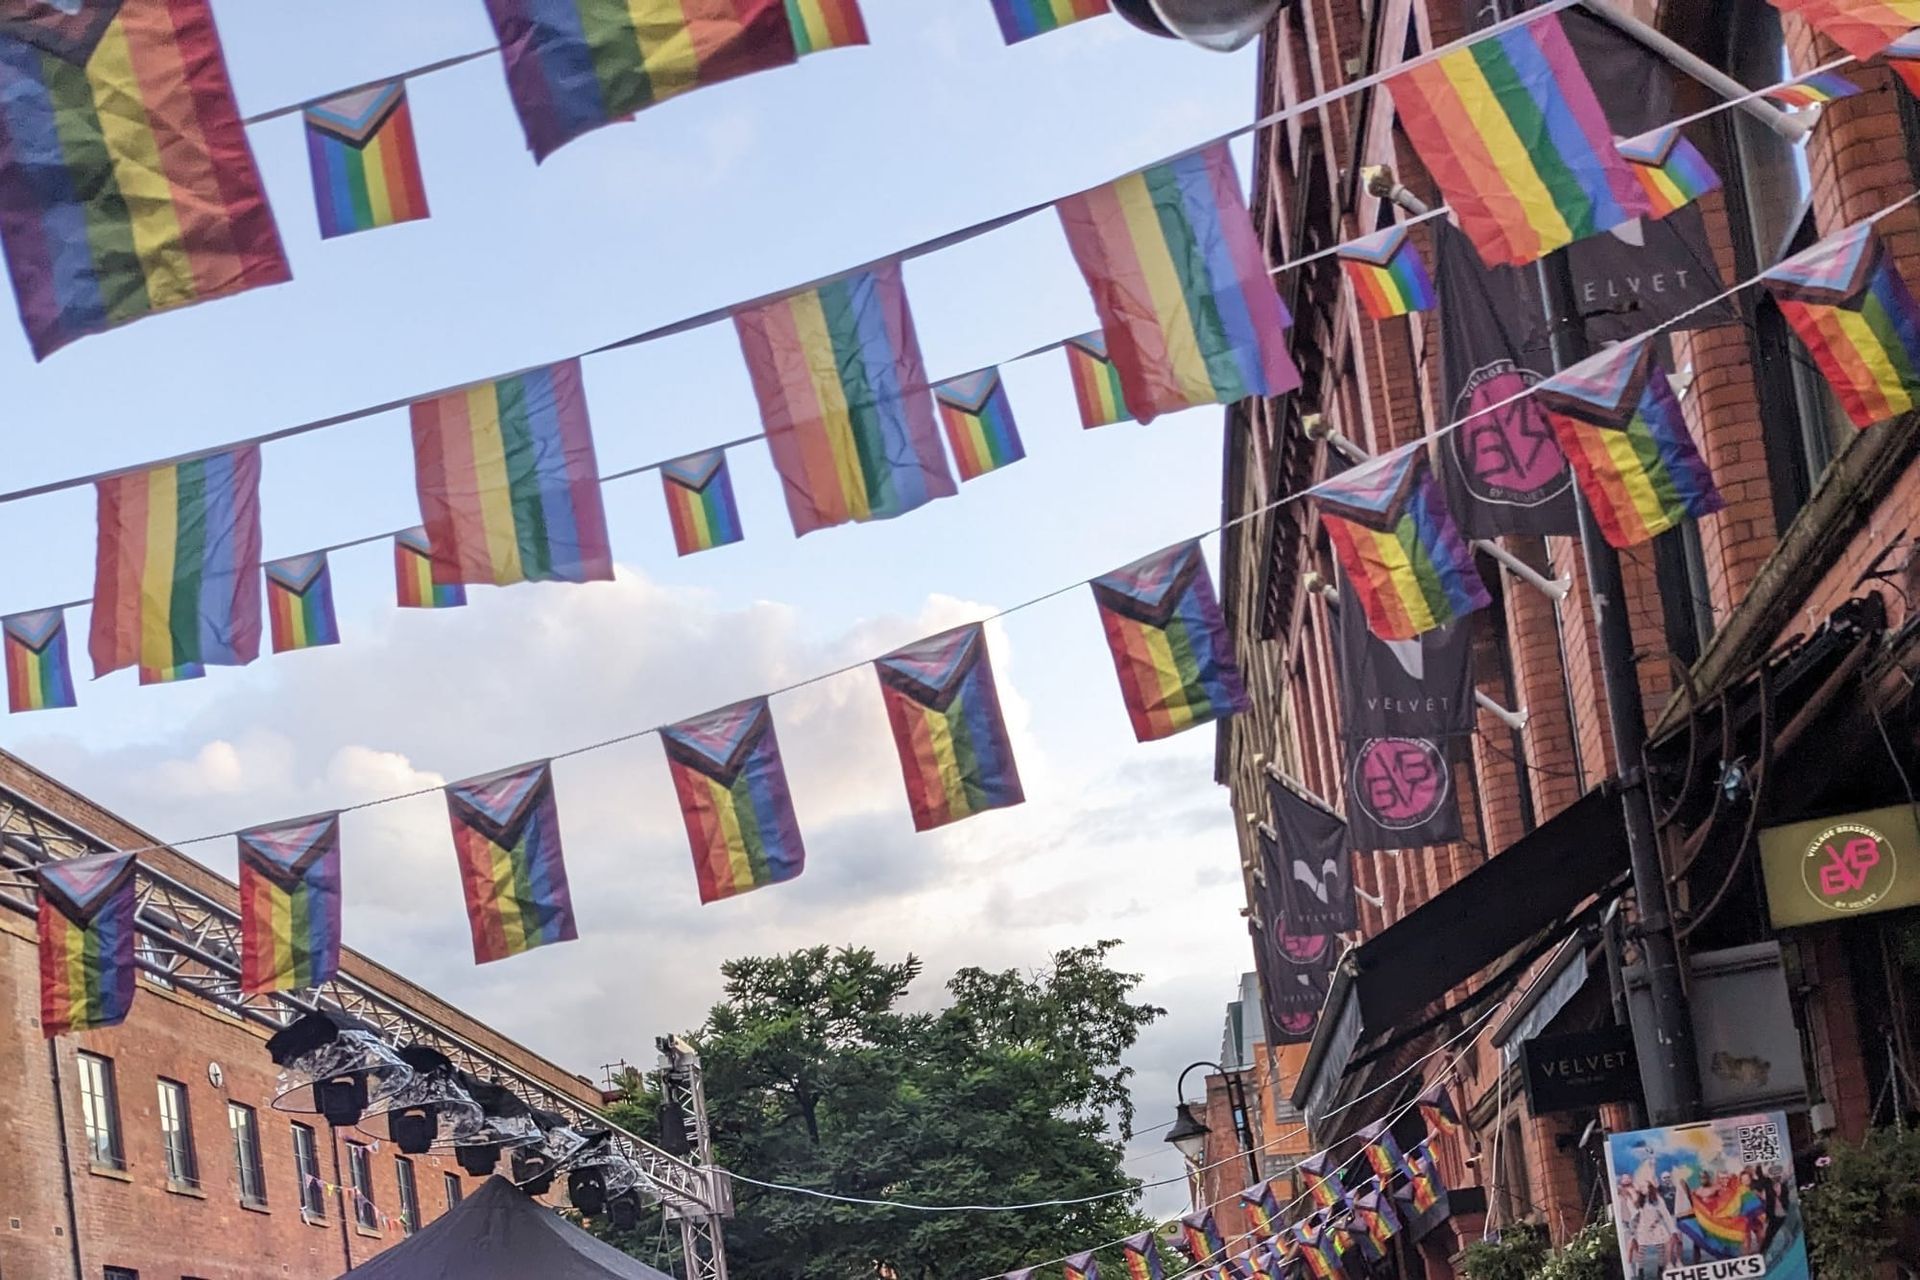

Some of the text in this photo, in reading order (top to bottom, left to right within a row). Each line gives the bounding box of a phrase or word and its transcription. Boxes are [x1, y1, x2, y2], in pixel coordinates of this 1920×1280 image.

[1583, 270, 1688, 302] ELVET
[1368, 698, 1449, 713] VELVET
[1806, 825, 1883, 858] VILLAGE BRASSERIE
[1541, 1051, 1626, 1077] VELVET
[1666, 1258, 1761, 1280] THE UK'S
